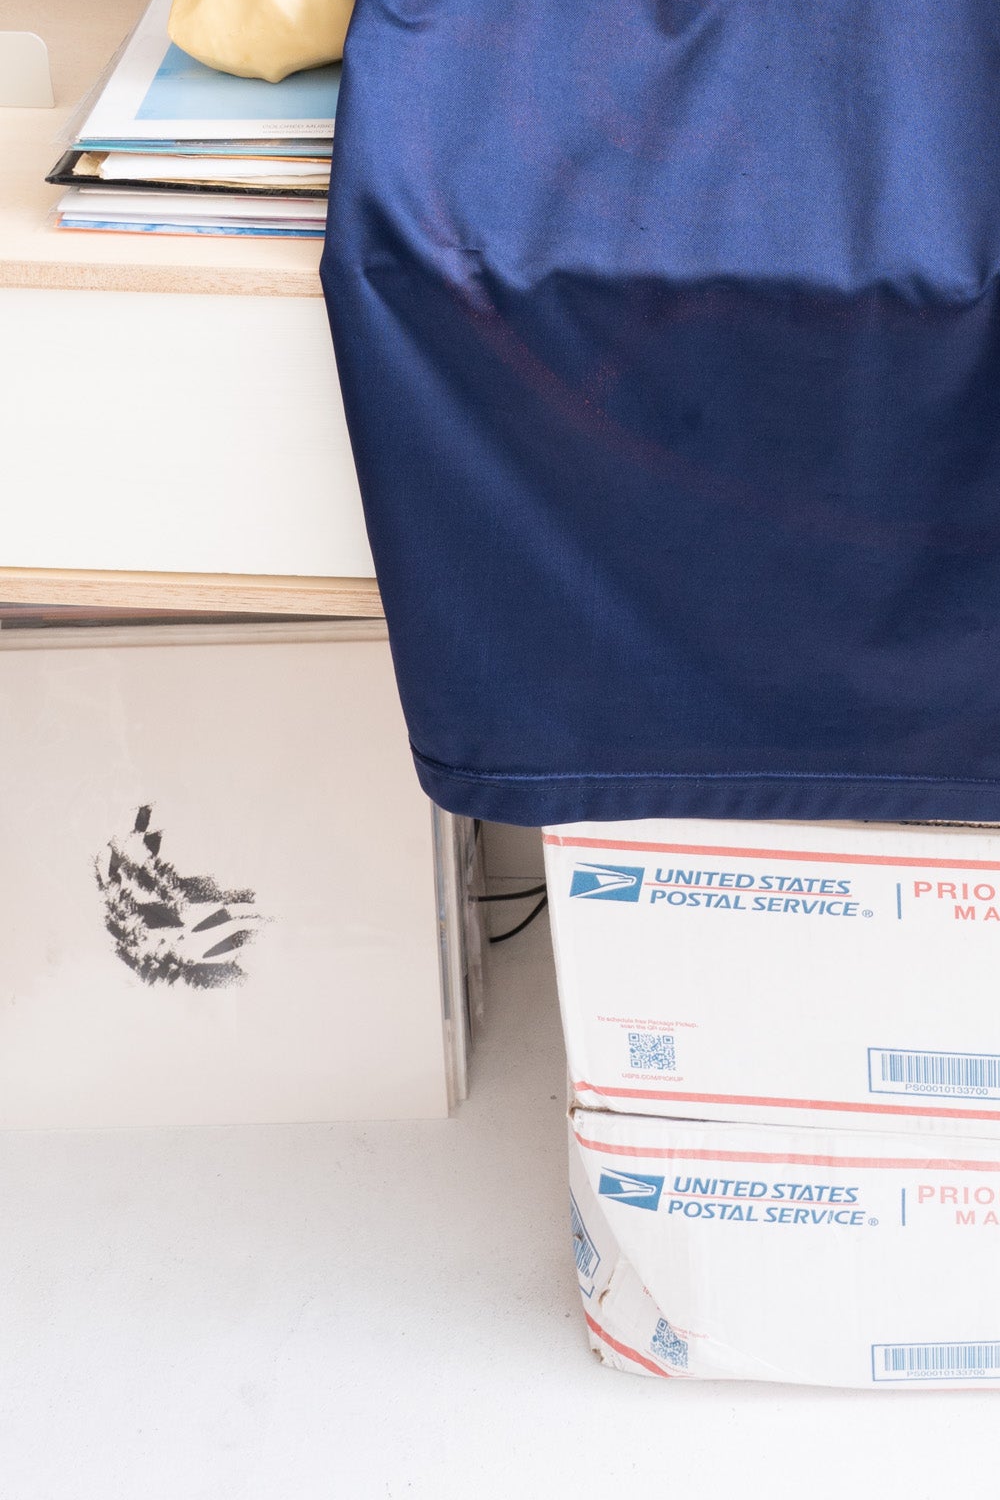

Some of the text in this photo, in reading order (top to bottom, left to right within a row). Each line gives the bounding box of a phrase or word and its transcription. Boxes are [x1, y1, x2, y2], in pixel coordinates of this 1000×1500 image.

[655, 868, 851, 894] UNITED STATES
[650, 890, 746, 910] POSTAL
[904, 1083, 989, 1096] PS00010133700
[673, 1177, 859, 1203] UNITED STATES
[668, 1200, 759, 1222] POSTAL
